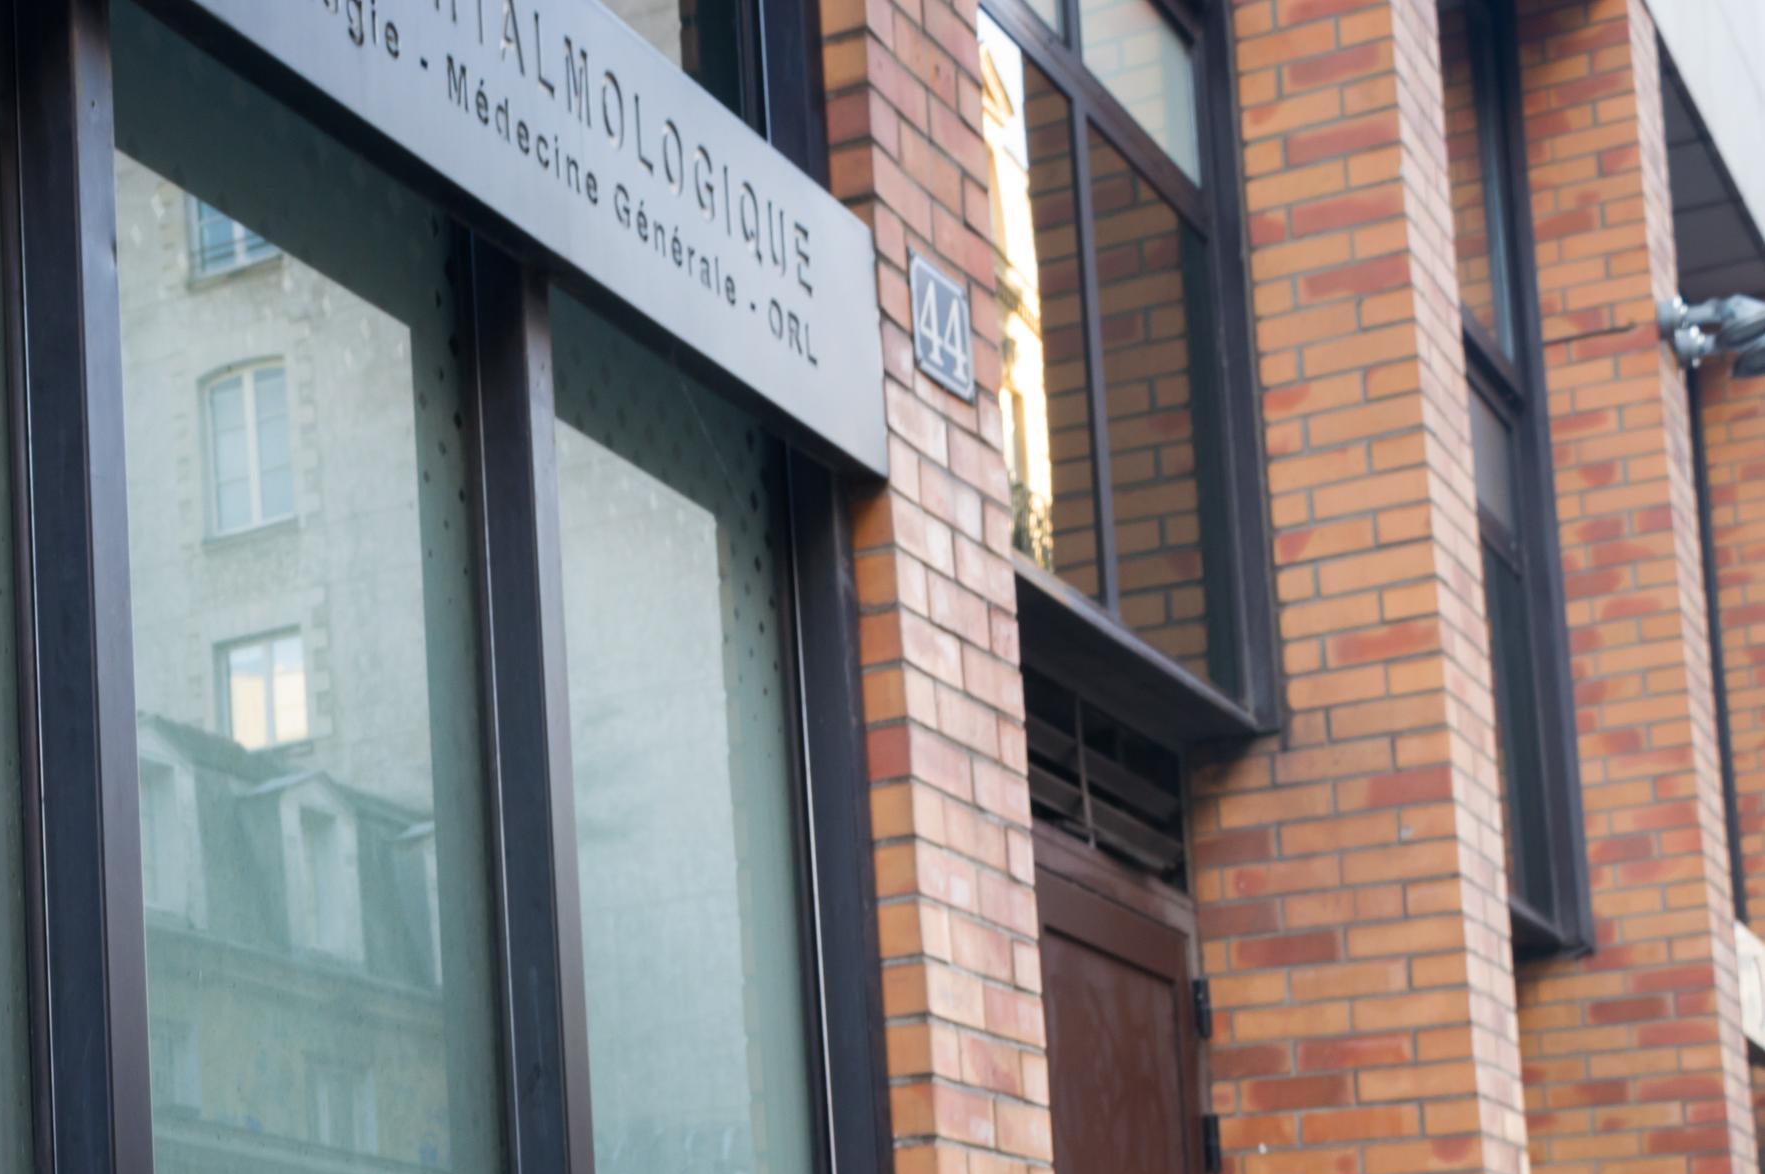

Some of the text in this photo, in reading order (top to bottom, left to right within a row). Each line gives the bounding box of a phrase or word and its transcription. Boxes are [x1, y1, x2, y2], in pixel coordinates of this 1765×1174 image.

[446, 53, 598, 205] Médecine
[614, 182, 736, 306] Générale
[767, 297, 818, 367] ORL
[920, 279, 969, 383] 44
